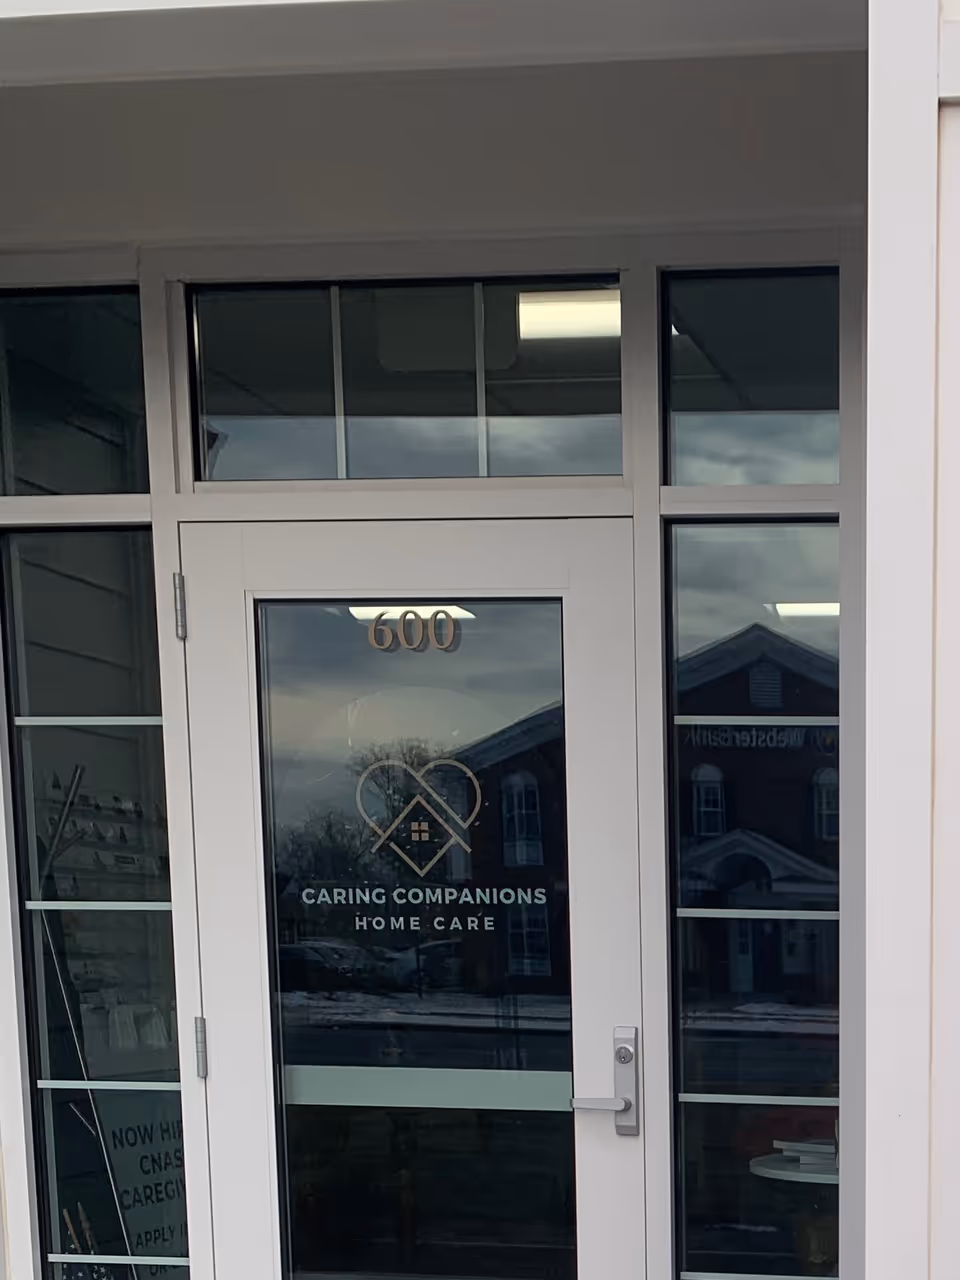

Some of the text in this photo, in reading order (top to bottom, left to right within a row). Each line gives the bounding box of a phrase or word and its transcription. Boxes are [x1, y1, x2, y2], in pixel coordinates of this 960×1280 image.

[368, 609, 456, 650] 600
[301, 887, 547, 905] CARING COMPANIONS
[354, 916, 495, 931] HOME CARE
[112, 1123, 154, 1150] NOW
[136, 1225, 176, 1249] APPLY
